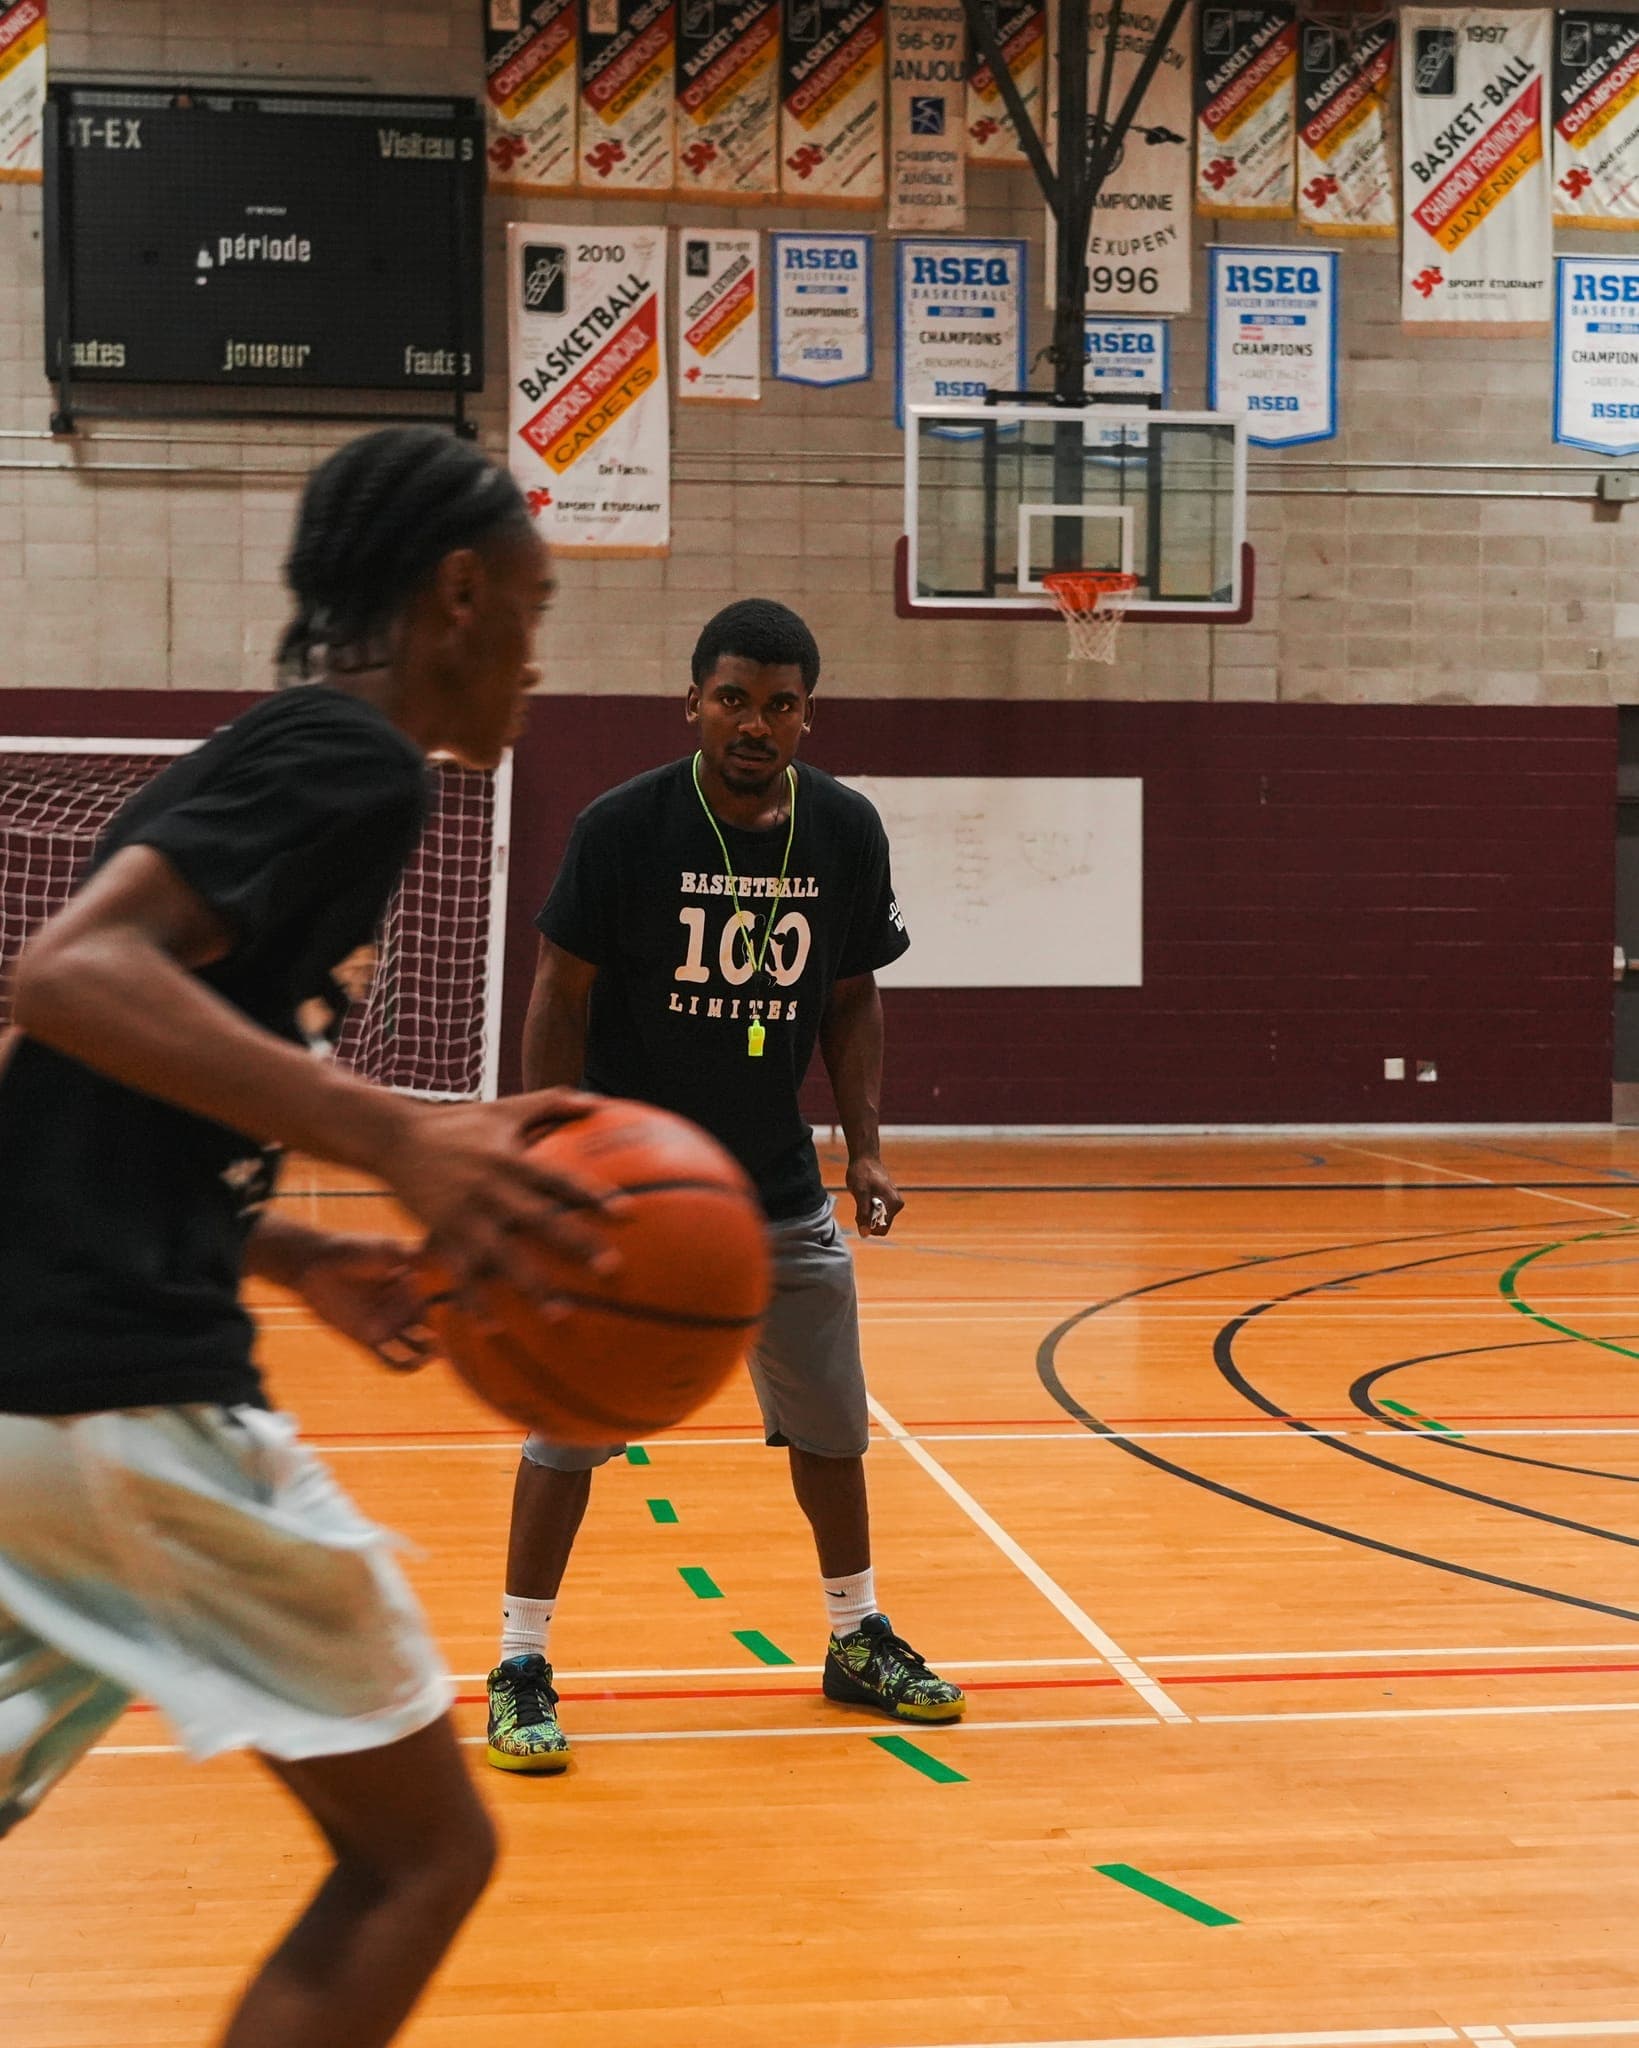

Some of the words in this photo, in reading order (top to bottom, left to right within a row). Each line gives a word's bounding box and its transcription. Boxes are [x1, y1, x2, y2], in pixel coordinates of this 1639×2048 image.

[897, 32, 958, 50] 96-97
[1466, 26, 1509, 43] 1997
[1206, 16, 1285, 94] BASKET-BALL
[893, 60, 964, 82] ANJOU
[1305, 35, 1386, 112] BASKET-BALL
[1562, 52, 1639, 133] CHAMPIONS
[1410, 56, 1535, 183] BASKET-BALL
[1419, 163, 1482, 227] CHAMPION
[1469, 108, 1535, 173] PROVINCIAL
[219, 233, 311, 266] période
[577, 245, 625, 262] 2010
[785, 248, 858, 269] RSEQ
[912, 257, 1010, 286] RSEQ
[1226, 265, 1321, 293] RSEQ
[1447, 279, 1484, 289] SPORT
[911, 289, 1008, 302] BASKETBALL
[518, 273, 650, 402] BASKETBALL
[919, 331, 1002, 346] CHAMPIONS
[1084, 332, 1155, 353] RSEQ
[1232, 343, 1313, 357] CHAMPIONS
[222, 340, 311, 370] joueur
[554, 367, 653, 464] CADETS
[1248, 396, 1299, 411] RSEQ
[681, 871, 819, 898] BASKETBALL
[668, 992, 798, 1021] LIMITES
